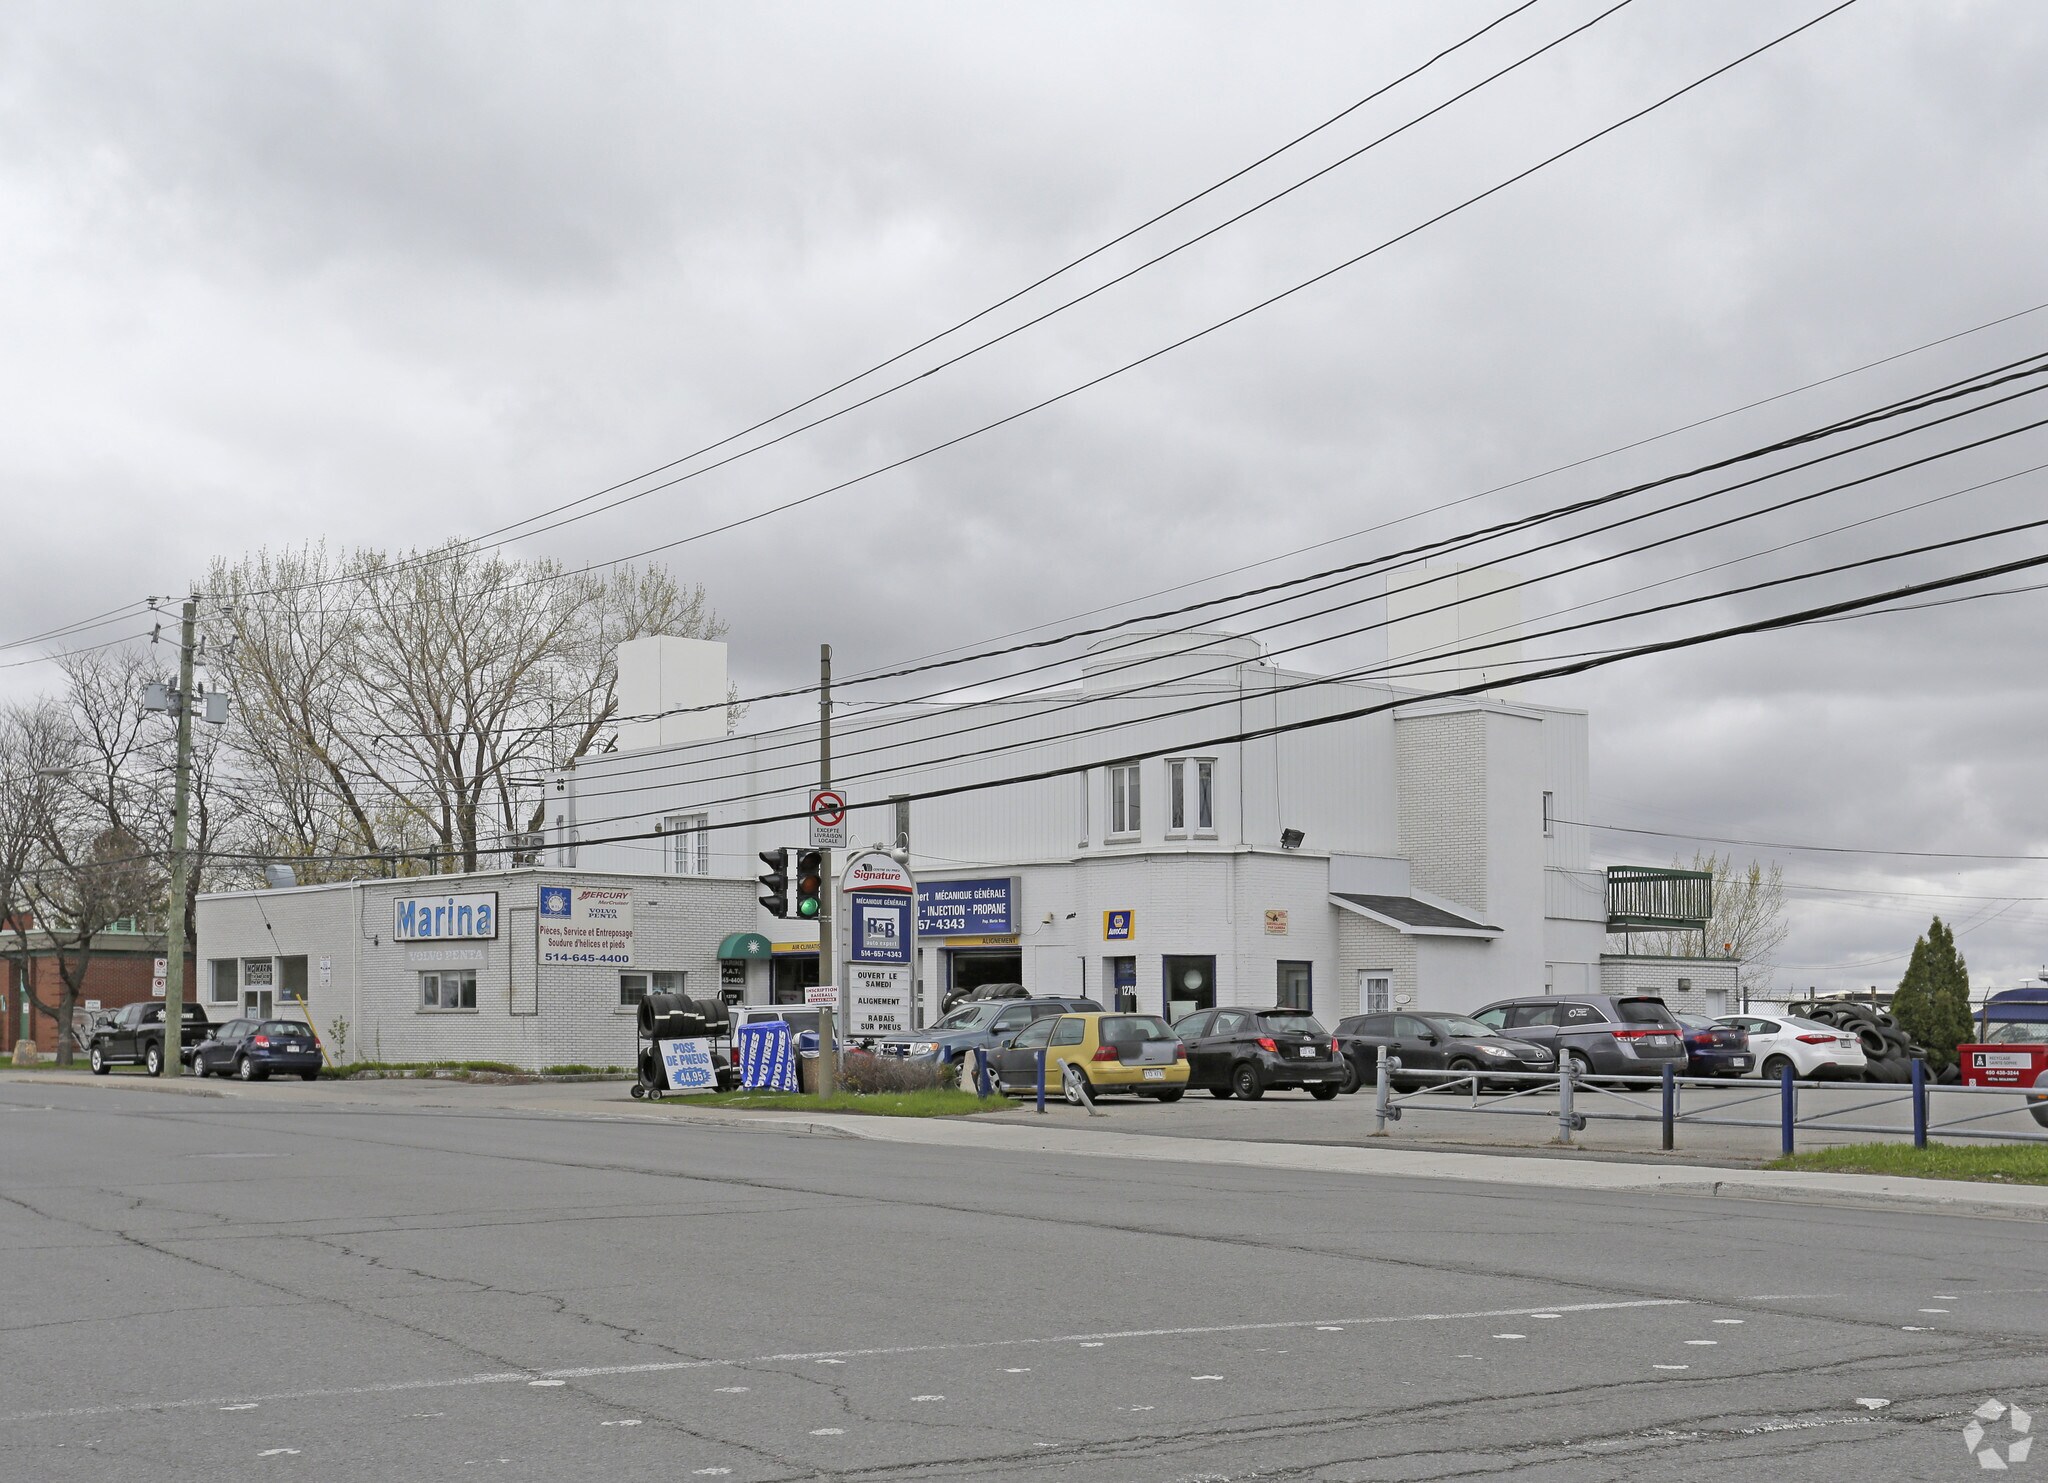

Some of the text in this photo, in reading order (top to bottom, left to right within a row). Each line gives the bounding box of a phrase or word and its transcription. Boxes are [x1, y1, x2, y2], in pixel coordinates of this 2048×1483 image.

[854, 870, 900, 880] Signature
[577, 891, 629, 901] MERCURY
[917, 887, 1006, 902] ert MÉCANIQUE GÉNÉRALE
[856, 898, 907, 907] MÉCANIQUE GÉNÉRALE
[927, 904, 966, 917] INJECTION
[972, 902, 1006, 915] PROPANE
[397, 898, 492, 938] Marina
[563, 927, 587, 937] Service
[588, 928, 595, 936] et
[595, 928, 633, 939] Entreposage
[867, 918, 895, 938] R&B
[548, 938, 573, 948] Soudure
[602, 940, 609, 949] et
[609, 940, 626, 950] pieds
[409, 949, 484, 961] VOLVO PENTA
[545, 953, 629, 963] 514-645-4400
[860, 950, 902, 958] 514-657-4343
[673, 1042, 697, 1054] POSE
[666, 1053, 709, 1067] DE PNEUS
[744, 1032, 760, 1088] OYO TIRES
[757, 1031, 774, 1087] OYO TIRES
[770, 1030, 786, 1088] OYO TIRES
